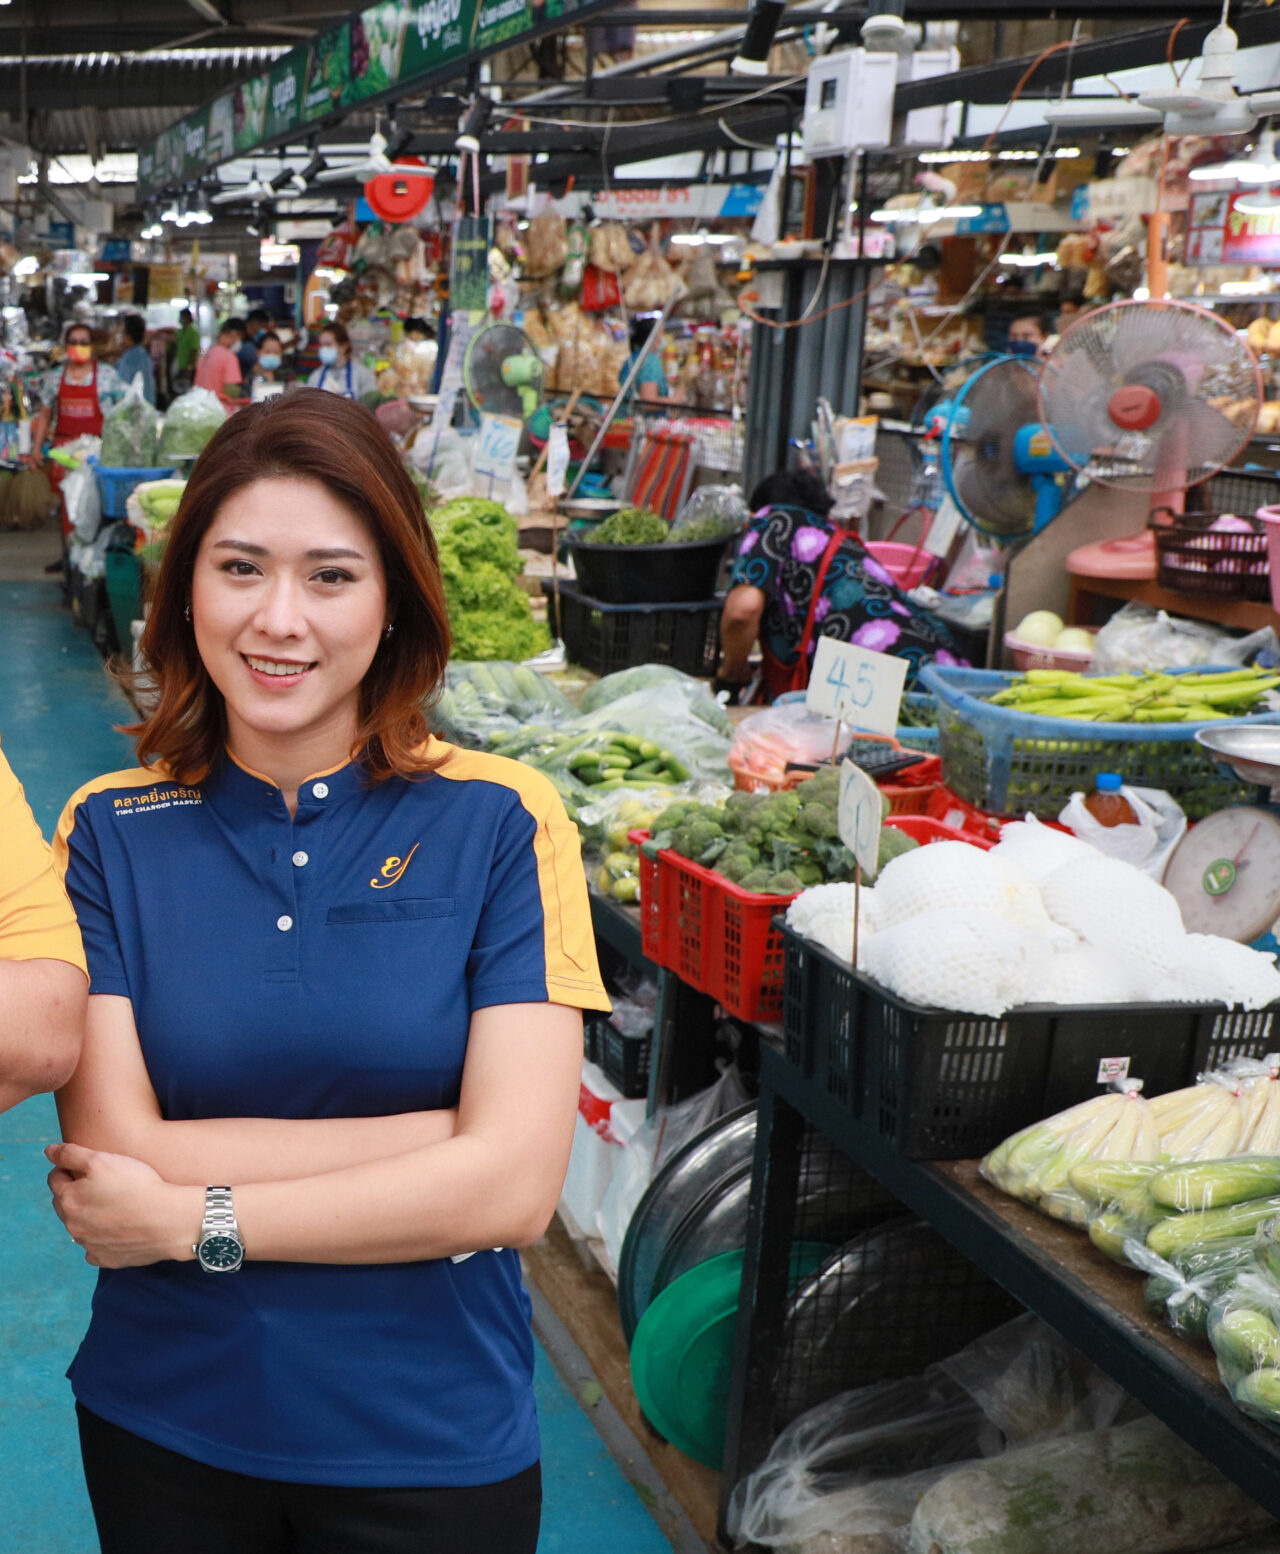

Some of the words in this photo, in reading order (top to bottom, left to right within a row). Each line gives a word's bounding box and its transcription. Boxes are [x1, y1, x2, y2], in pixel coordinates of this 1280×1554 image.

[825, 655, 876, 709] 45
[114, 808, 134, 817] YING
[134, 802, 172, 814] CHAROEN
